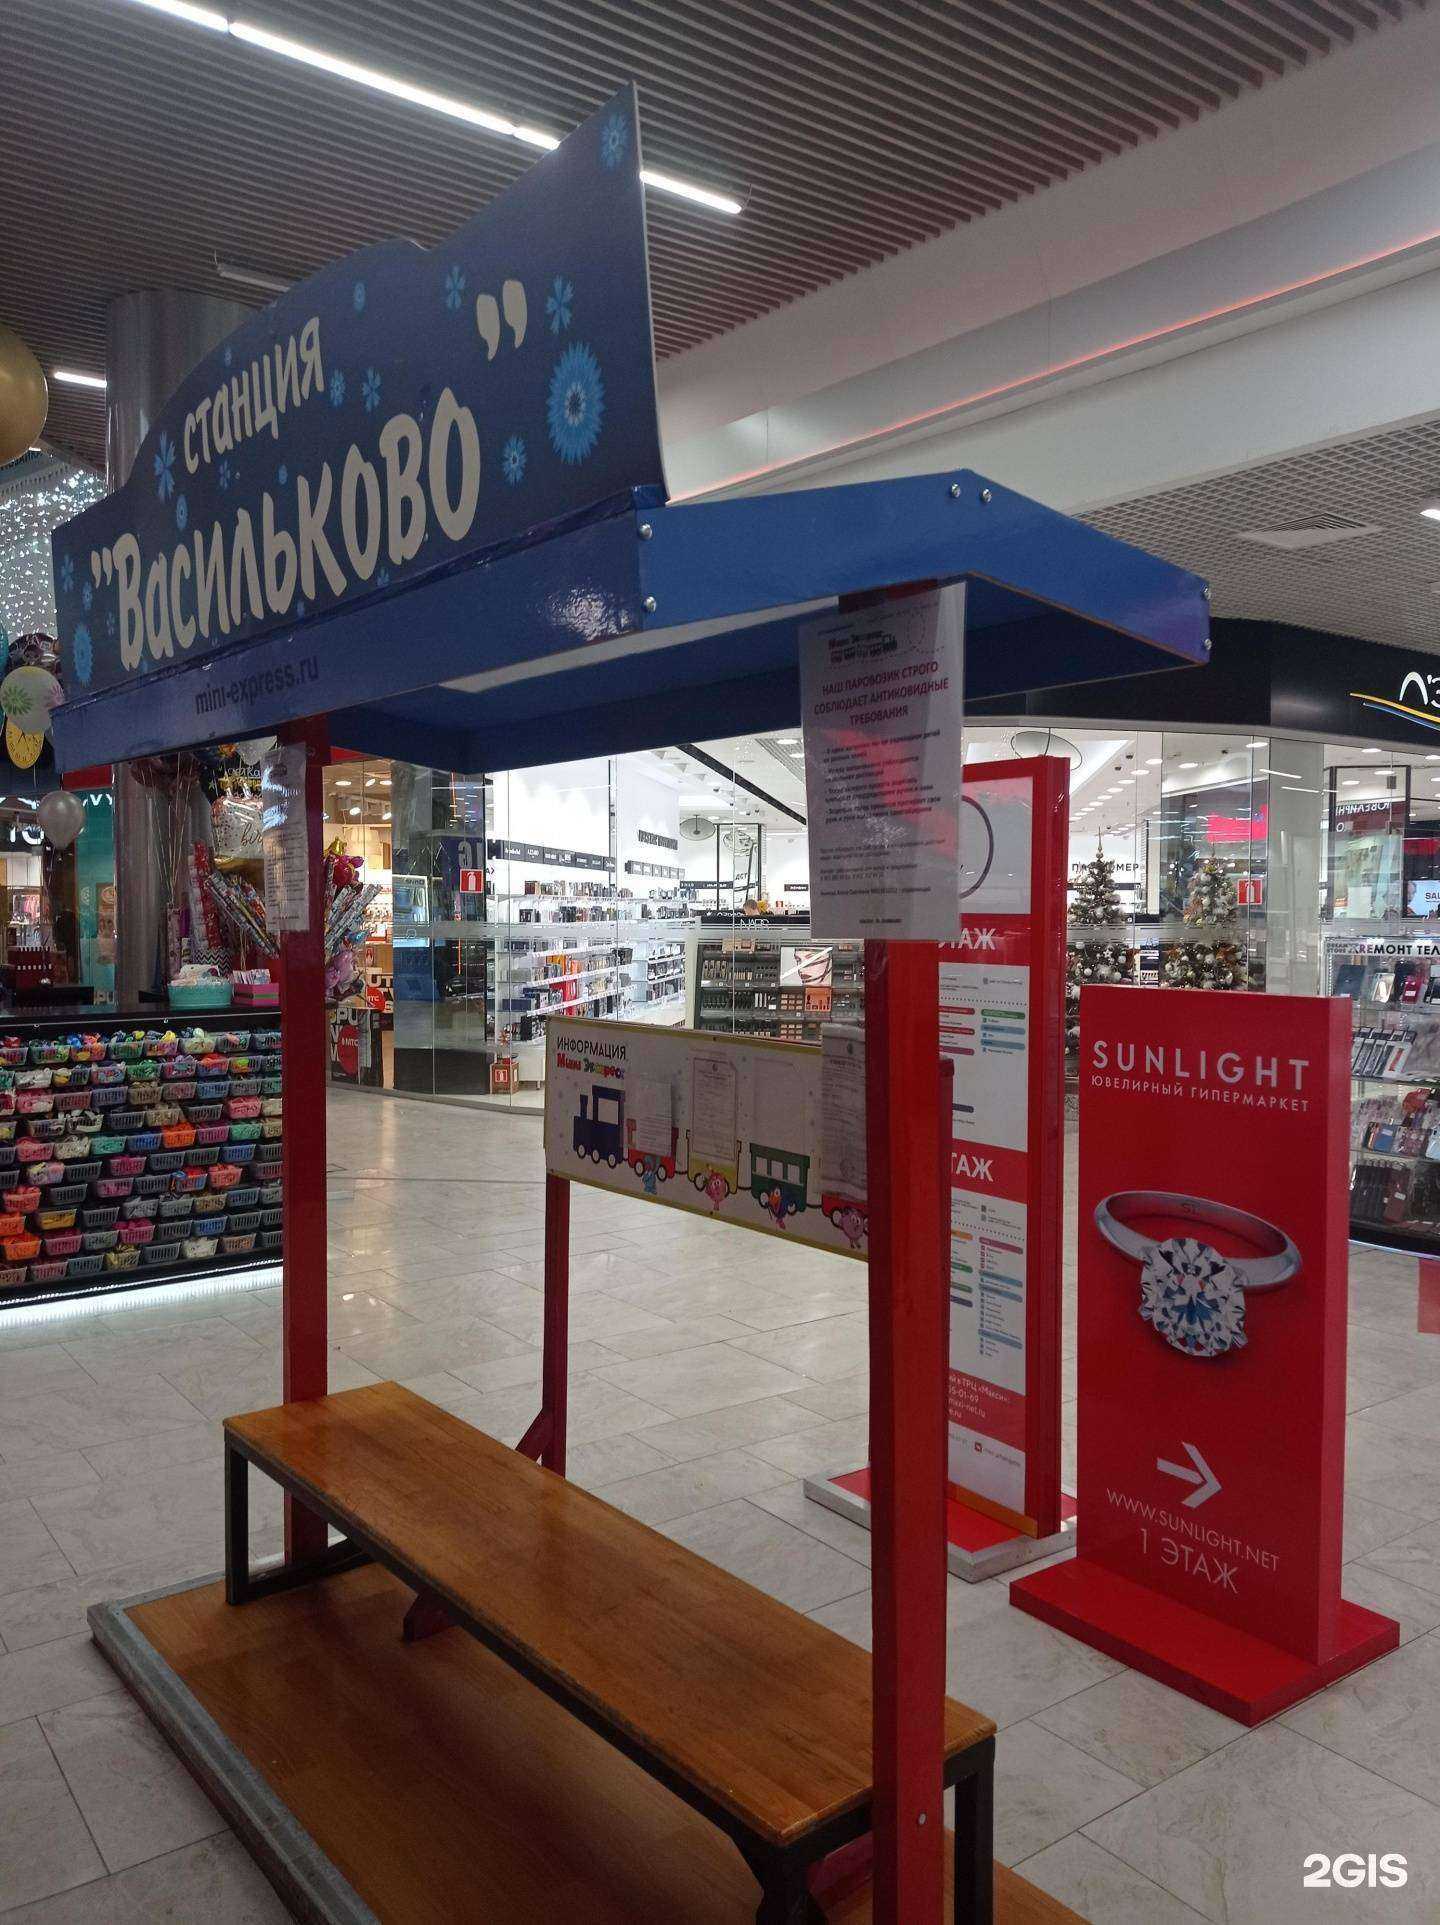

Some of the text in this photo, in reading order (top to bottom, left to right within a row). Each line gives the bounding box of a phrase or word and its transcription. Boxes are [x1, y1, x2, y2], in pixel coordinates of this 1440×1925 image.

[195, 655, 319, 715] mini-express.ru
[814, 677, 949, 716] СОБЛЮДАЕТ АНТИКОВИДНЫЕ
[823, 661, 939, 696] НАШ ПАРОВОЗИК СТРОГО
[850, 705, 909, 727] ТРЕБОВАНИЯ
[556, 1036, 626, 1060] ИНФОРМАЦИЯ
[1092, 1040, 1310, 1091] SUNLIGHT
[1091, 1075, 1310, 1113] ЮВЕЛИРНЫЙ ГИПЕРМАРКЕТ
[1106, 1487, 1280, 1572] WWW.SUNLIGHT.NET
[1140, 1528, 1239, 1594] 1 ЭТАЖ
